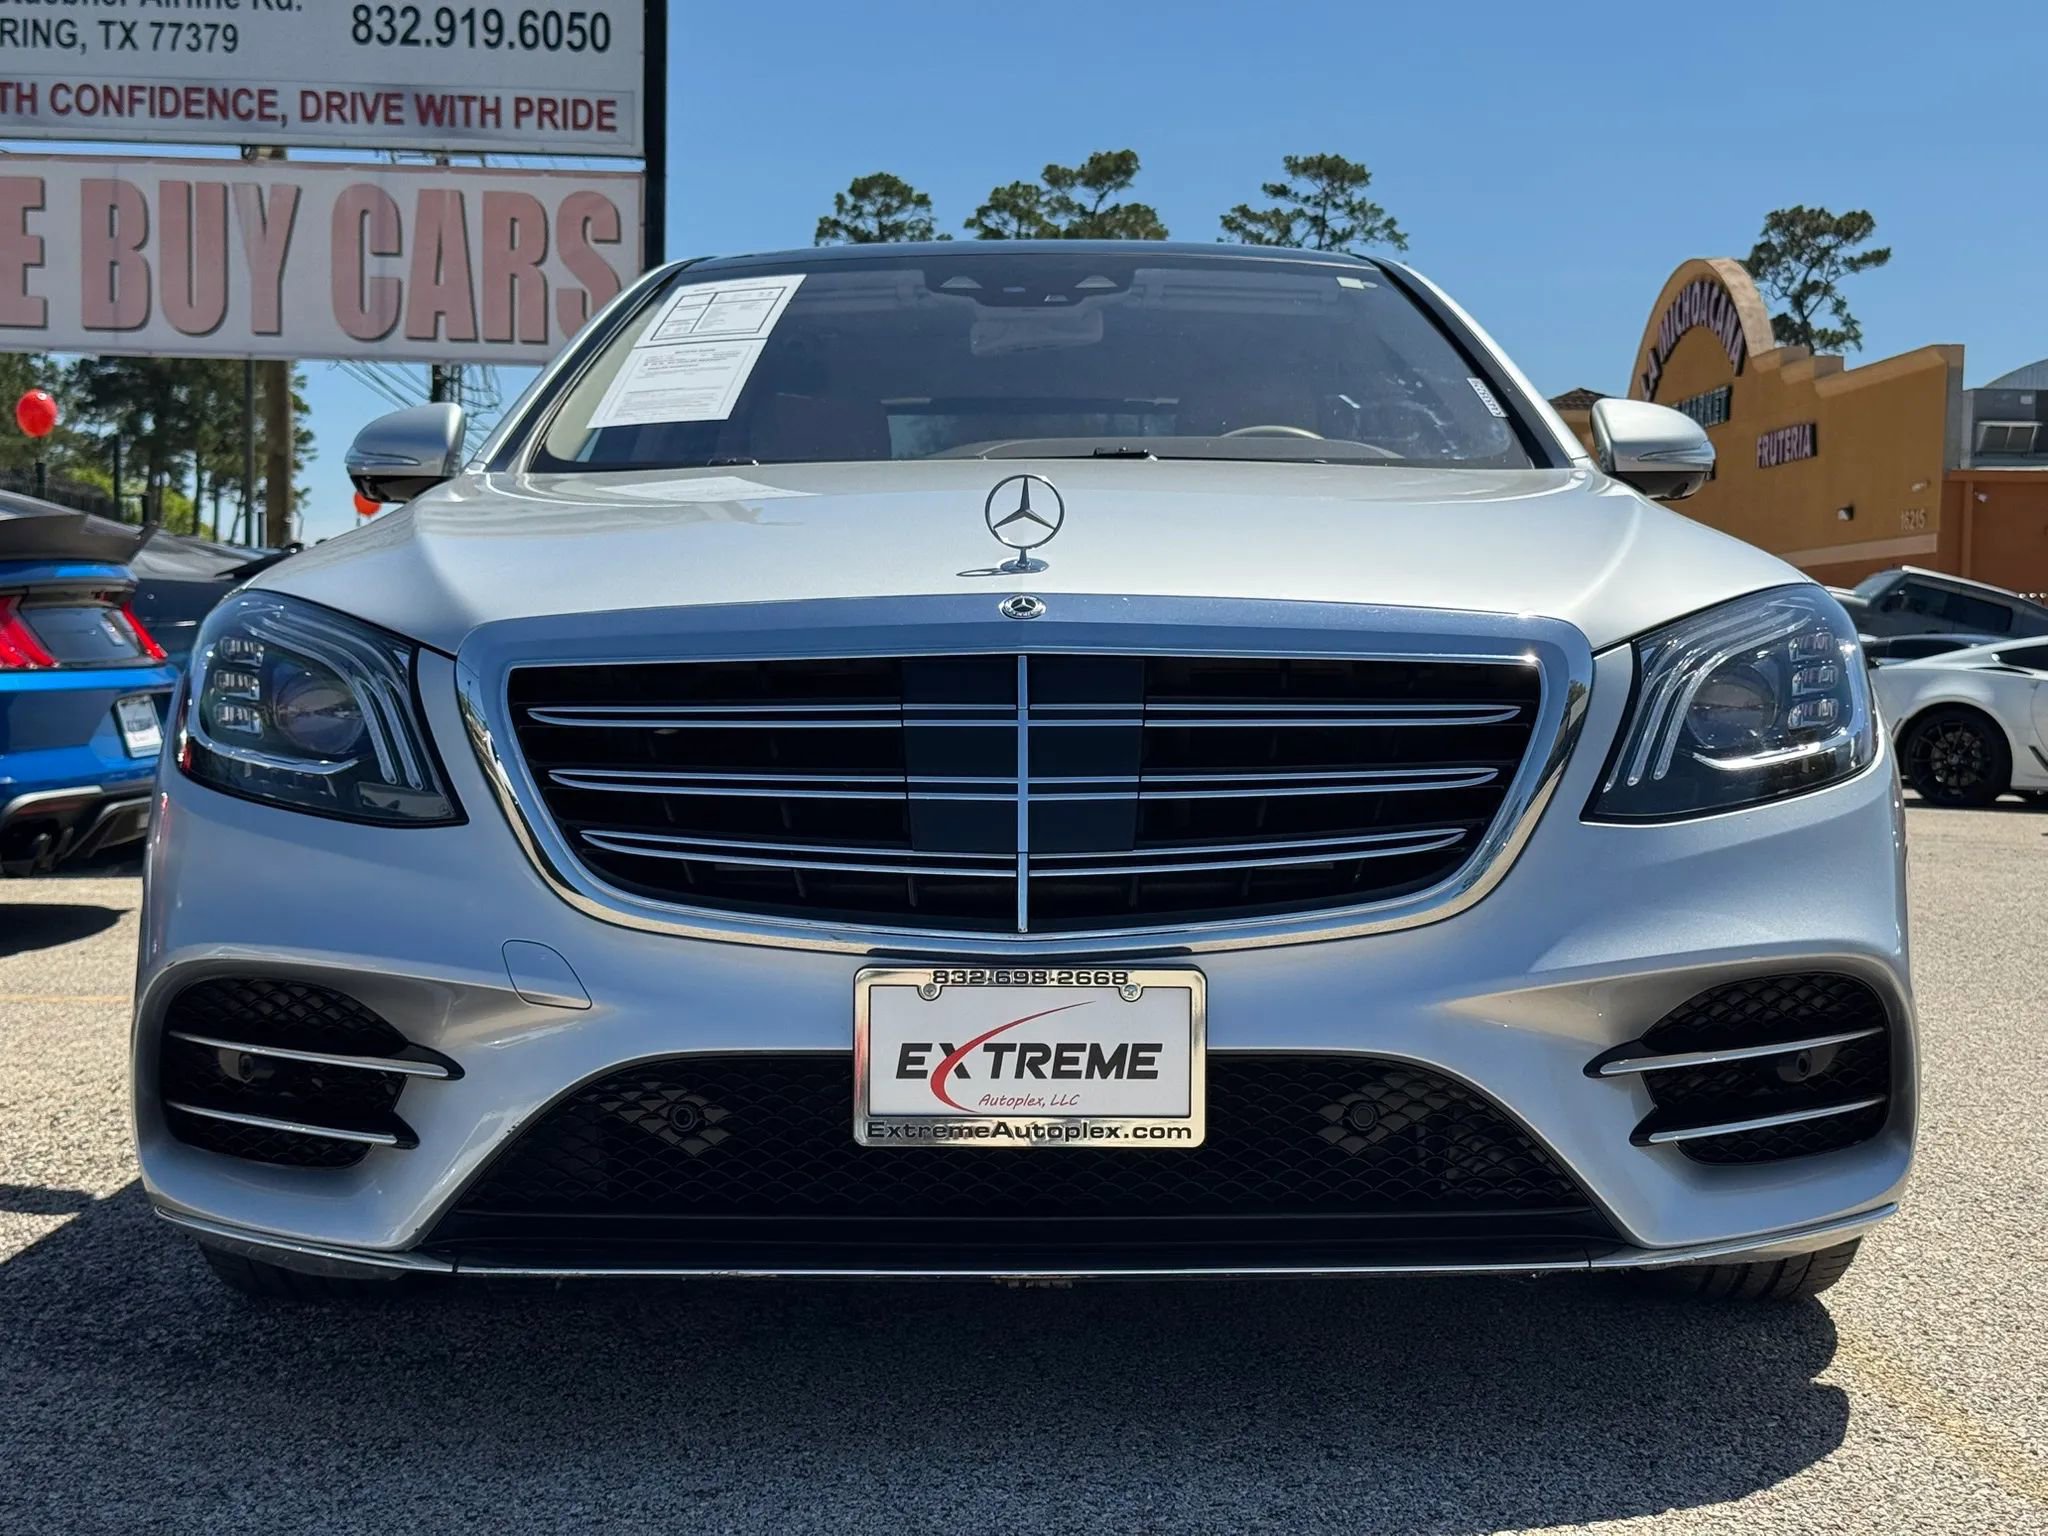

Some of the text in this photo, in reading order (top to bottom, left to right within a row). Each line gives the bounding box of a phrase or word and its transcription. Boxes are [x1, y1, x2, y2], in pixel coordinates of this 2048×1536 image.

[0, 18, 239, 54] RING, TX 77379
[352, 4, 612, 53] 832.919.6050
[50, 83, 288, 128] CONFIDENCE,
[300, 90, 404, 125] DRIVE
[414, 93, 502, 129] WITH
[514, 96, 617, 133] PRIDE
[80, 178, 302, 338] BUY
[331, 183, 622, 344] CARS
[1657, 279, 1744, 377] MICHOACANA
[1756, 423, 1815, 469] FRUTERIA
[932, 970, 1129, 985] 832-698-2668
[895, 1042, 1163, 1080] EXTREME
[978, 1093, 1080, 1110] Autoplex, LLC
[866, 1121, 1192, 1143] ExtremeAutoplex.com
